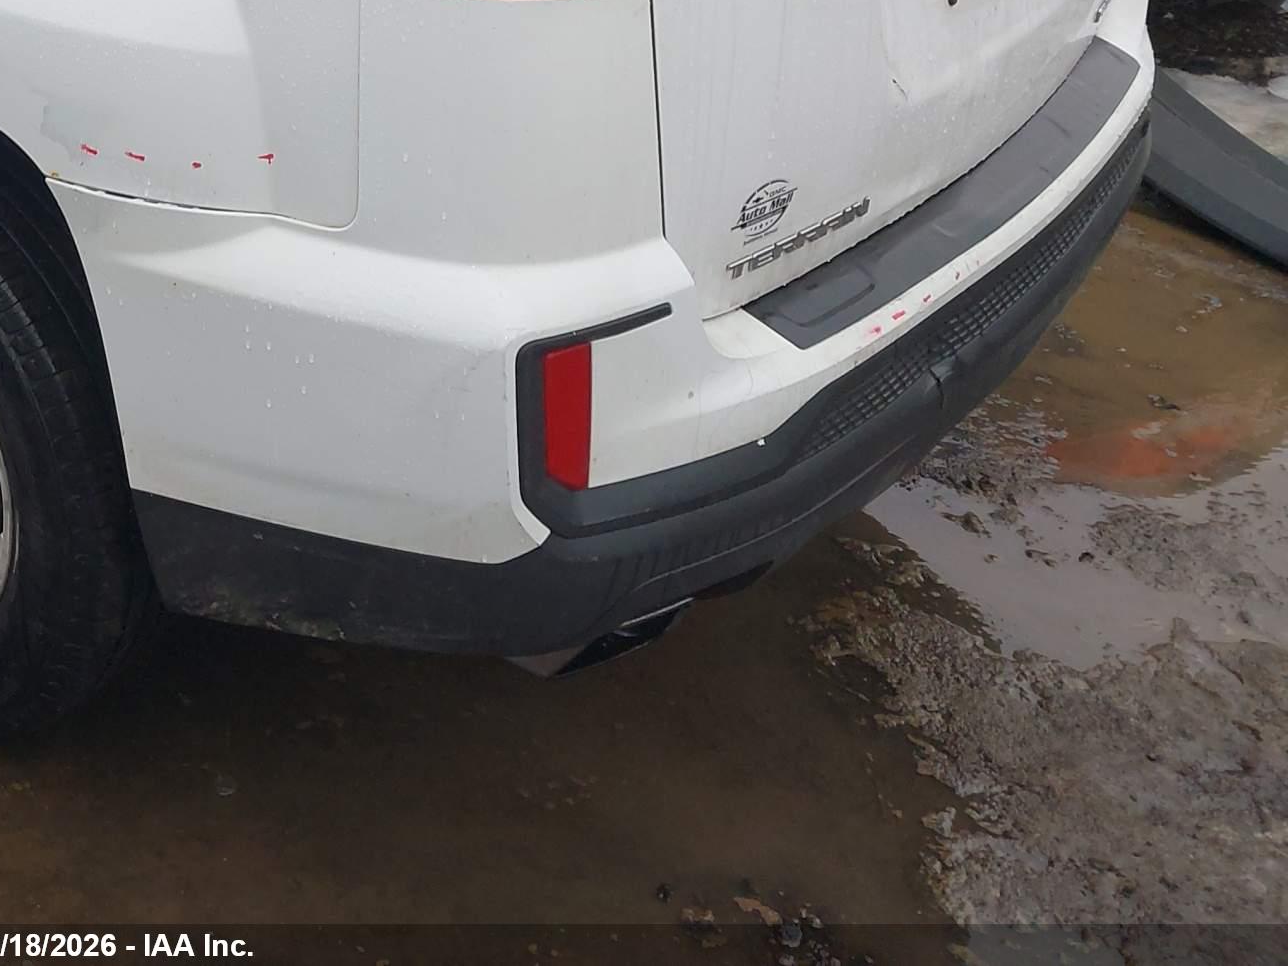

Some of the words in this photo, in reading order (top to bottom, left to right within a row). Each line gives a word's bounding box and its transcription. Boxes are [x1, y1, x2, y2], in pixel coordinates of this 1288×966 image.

[726, 195, 871, 280] TERRAIN
[737, 205, 767, 225] Auto
[769, 191, 794, 212] Mall
